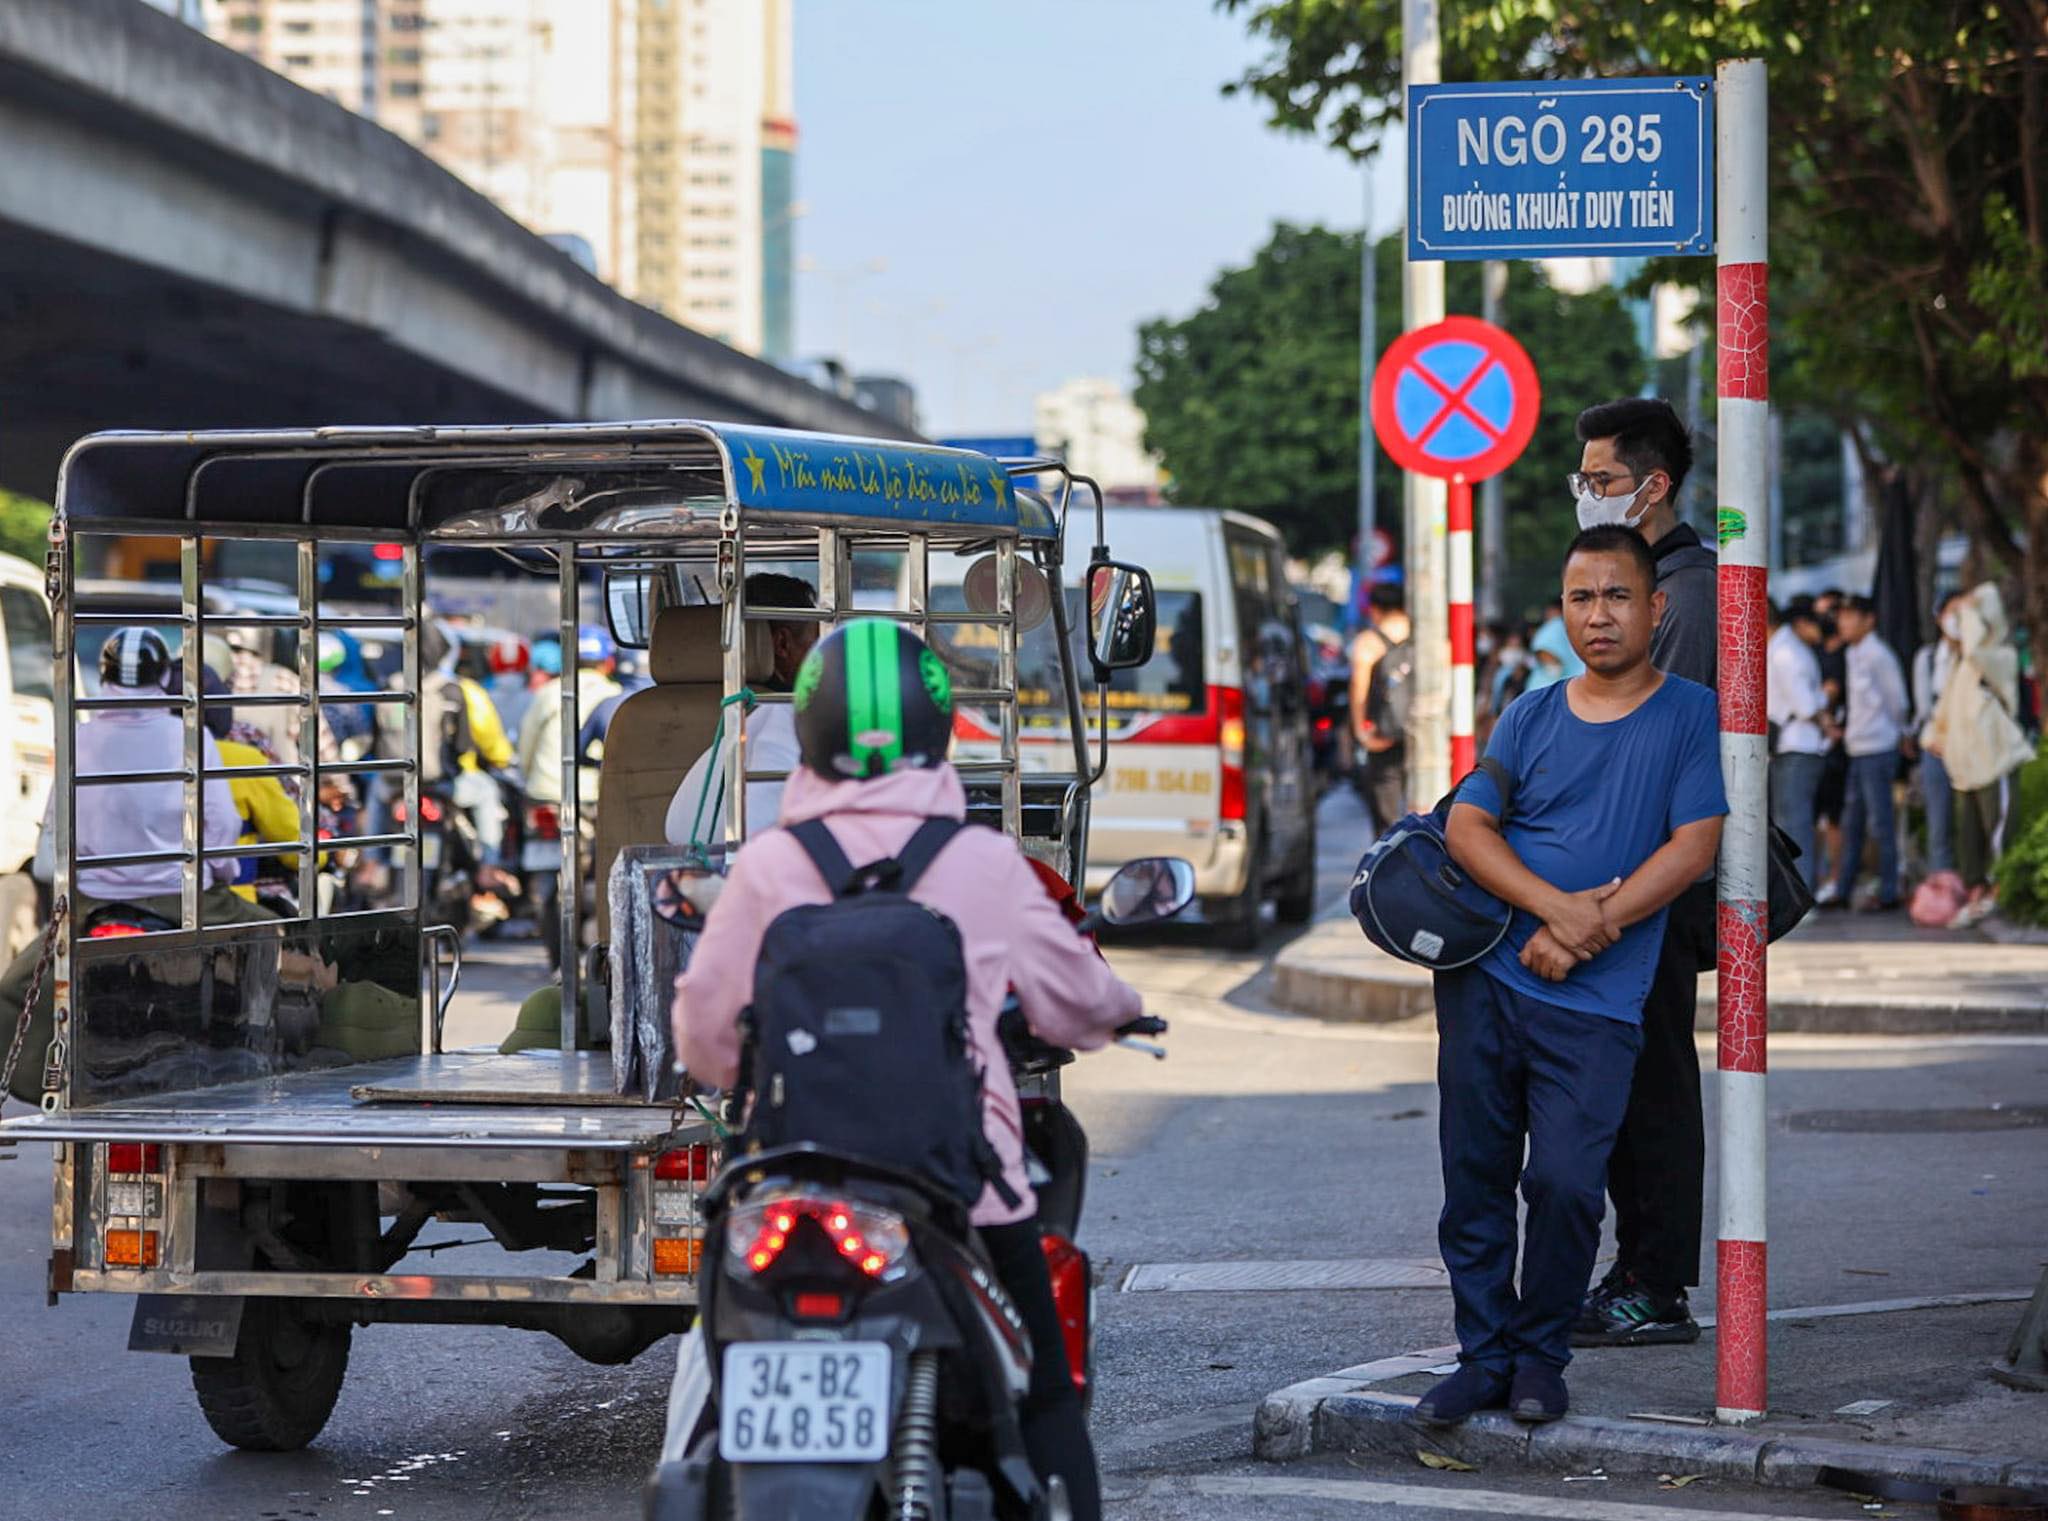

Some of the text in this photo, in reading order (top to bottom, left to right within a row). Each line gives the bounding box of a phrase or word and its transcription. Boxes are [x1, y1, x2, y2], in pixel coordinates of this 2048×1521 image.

[1457, 98, 1662, 167] NGÕ 285
[1443, 170, 1674, 231] ĐƯỜNG KHUẤT DUY TIẾN
[143, 1317, 226, 1338] SUZUKI
[751, 1354, 862, 1399] 34-B2
[734, 1406, 875, 1450] 648.58
